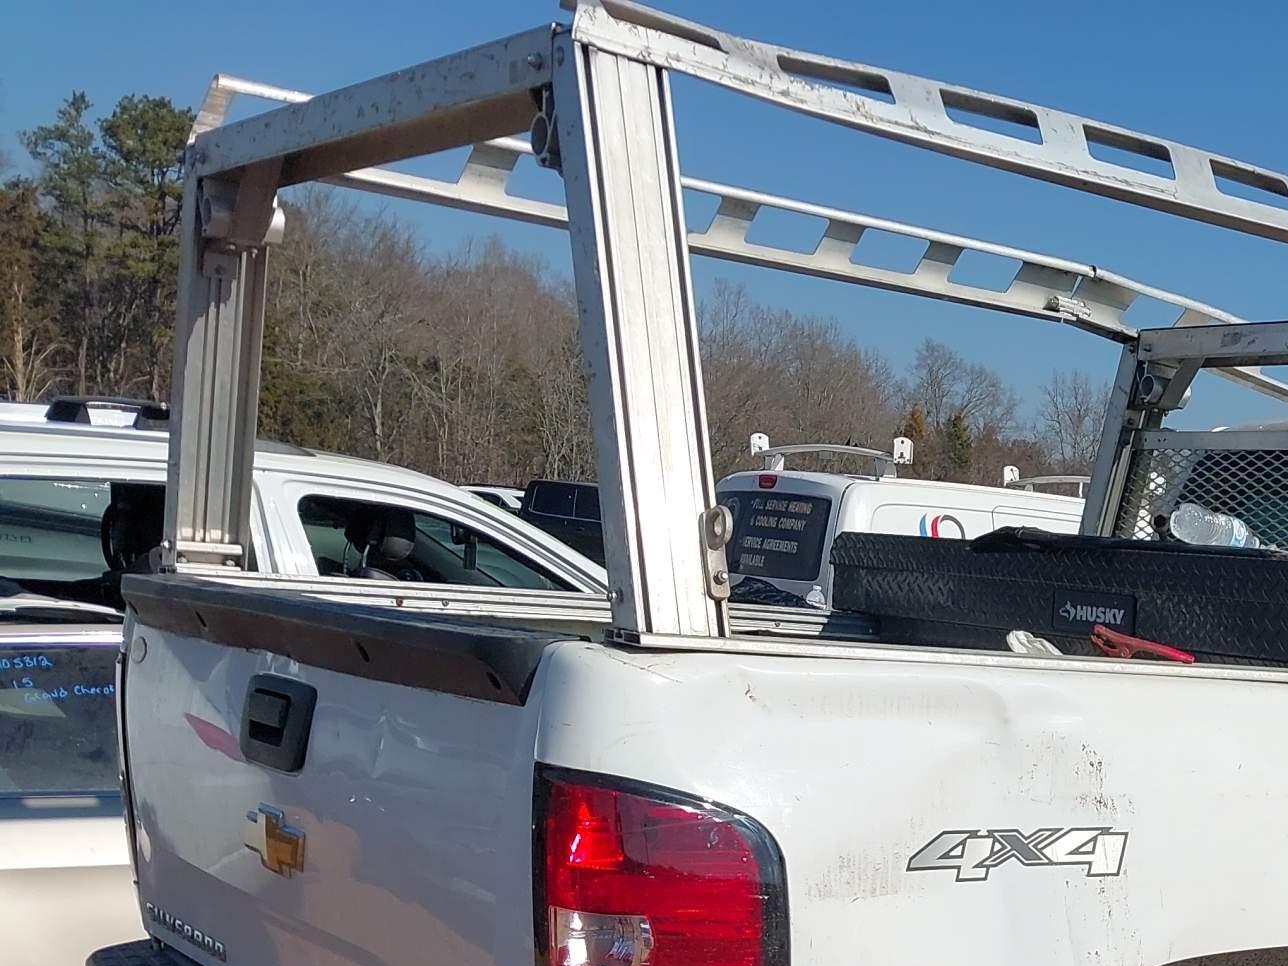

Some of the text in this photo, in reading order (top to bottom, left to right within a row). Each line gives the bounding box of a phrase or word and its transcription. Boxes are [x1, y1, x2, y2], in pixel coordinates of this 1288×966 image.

[788, 502, 813, 514] HEATING
[756, 515, 778, 528] COOLING
[778, 517, 807, 531] COMPANY
[763, 538, 798, 554] AGREEMENTS
[1076, 605, 1125, 624] HUSKY
[146, 902, 227, 962] SILVERADO
